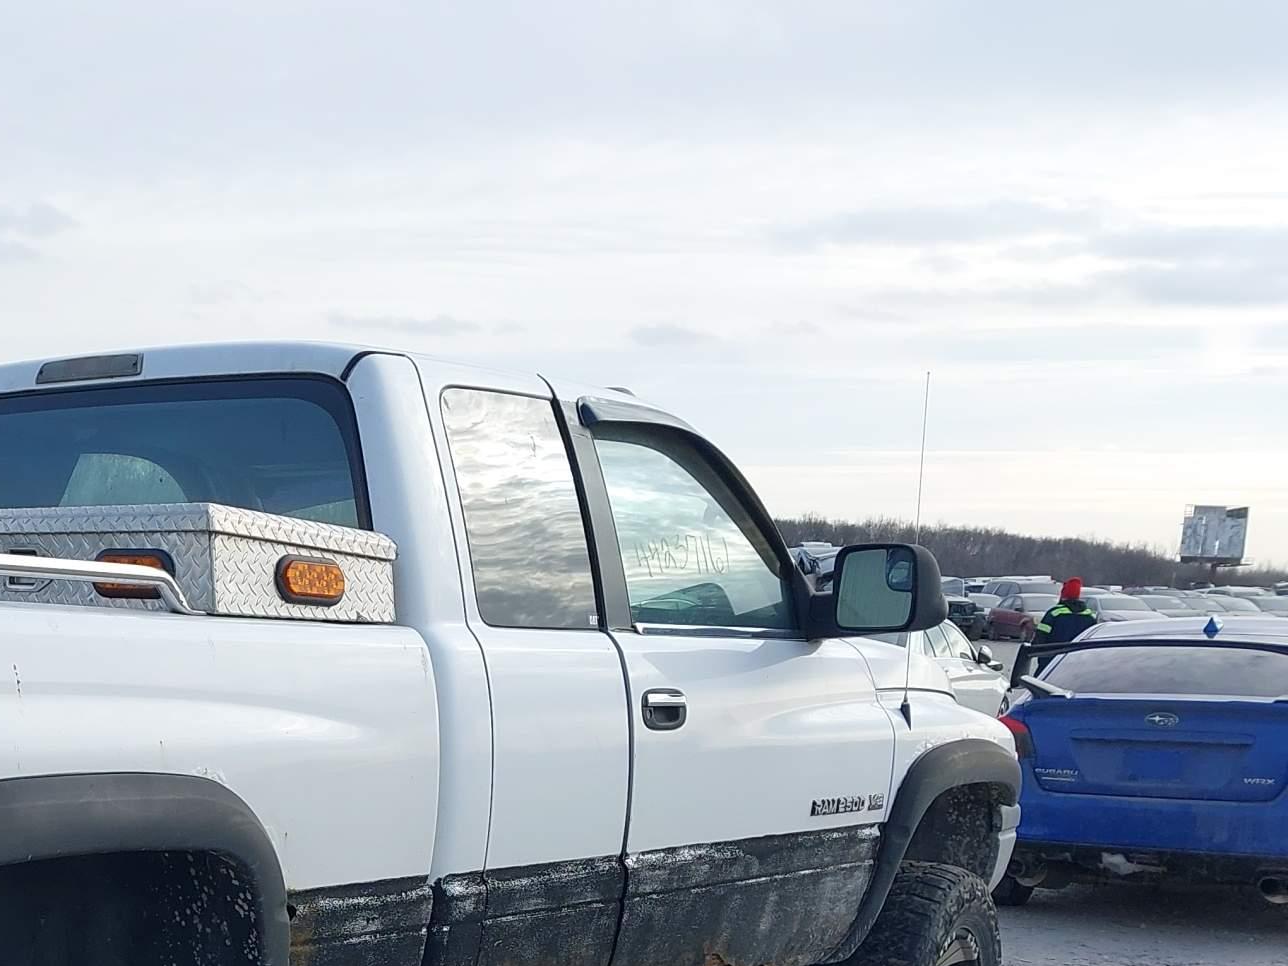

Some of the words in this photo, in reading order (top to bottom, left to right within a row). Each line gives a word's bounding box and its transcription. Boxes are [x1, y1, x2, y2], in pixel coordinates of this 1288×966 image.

[1035, 768, 1079, 776] SUBARU
[1243, 777, 1275, 785] WRX
[810, 798, 840, 816] RAM
[839, 796, 865, 812] 2500
